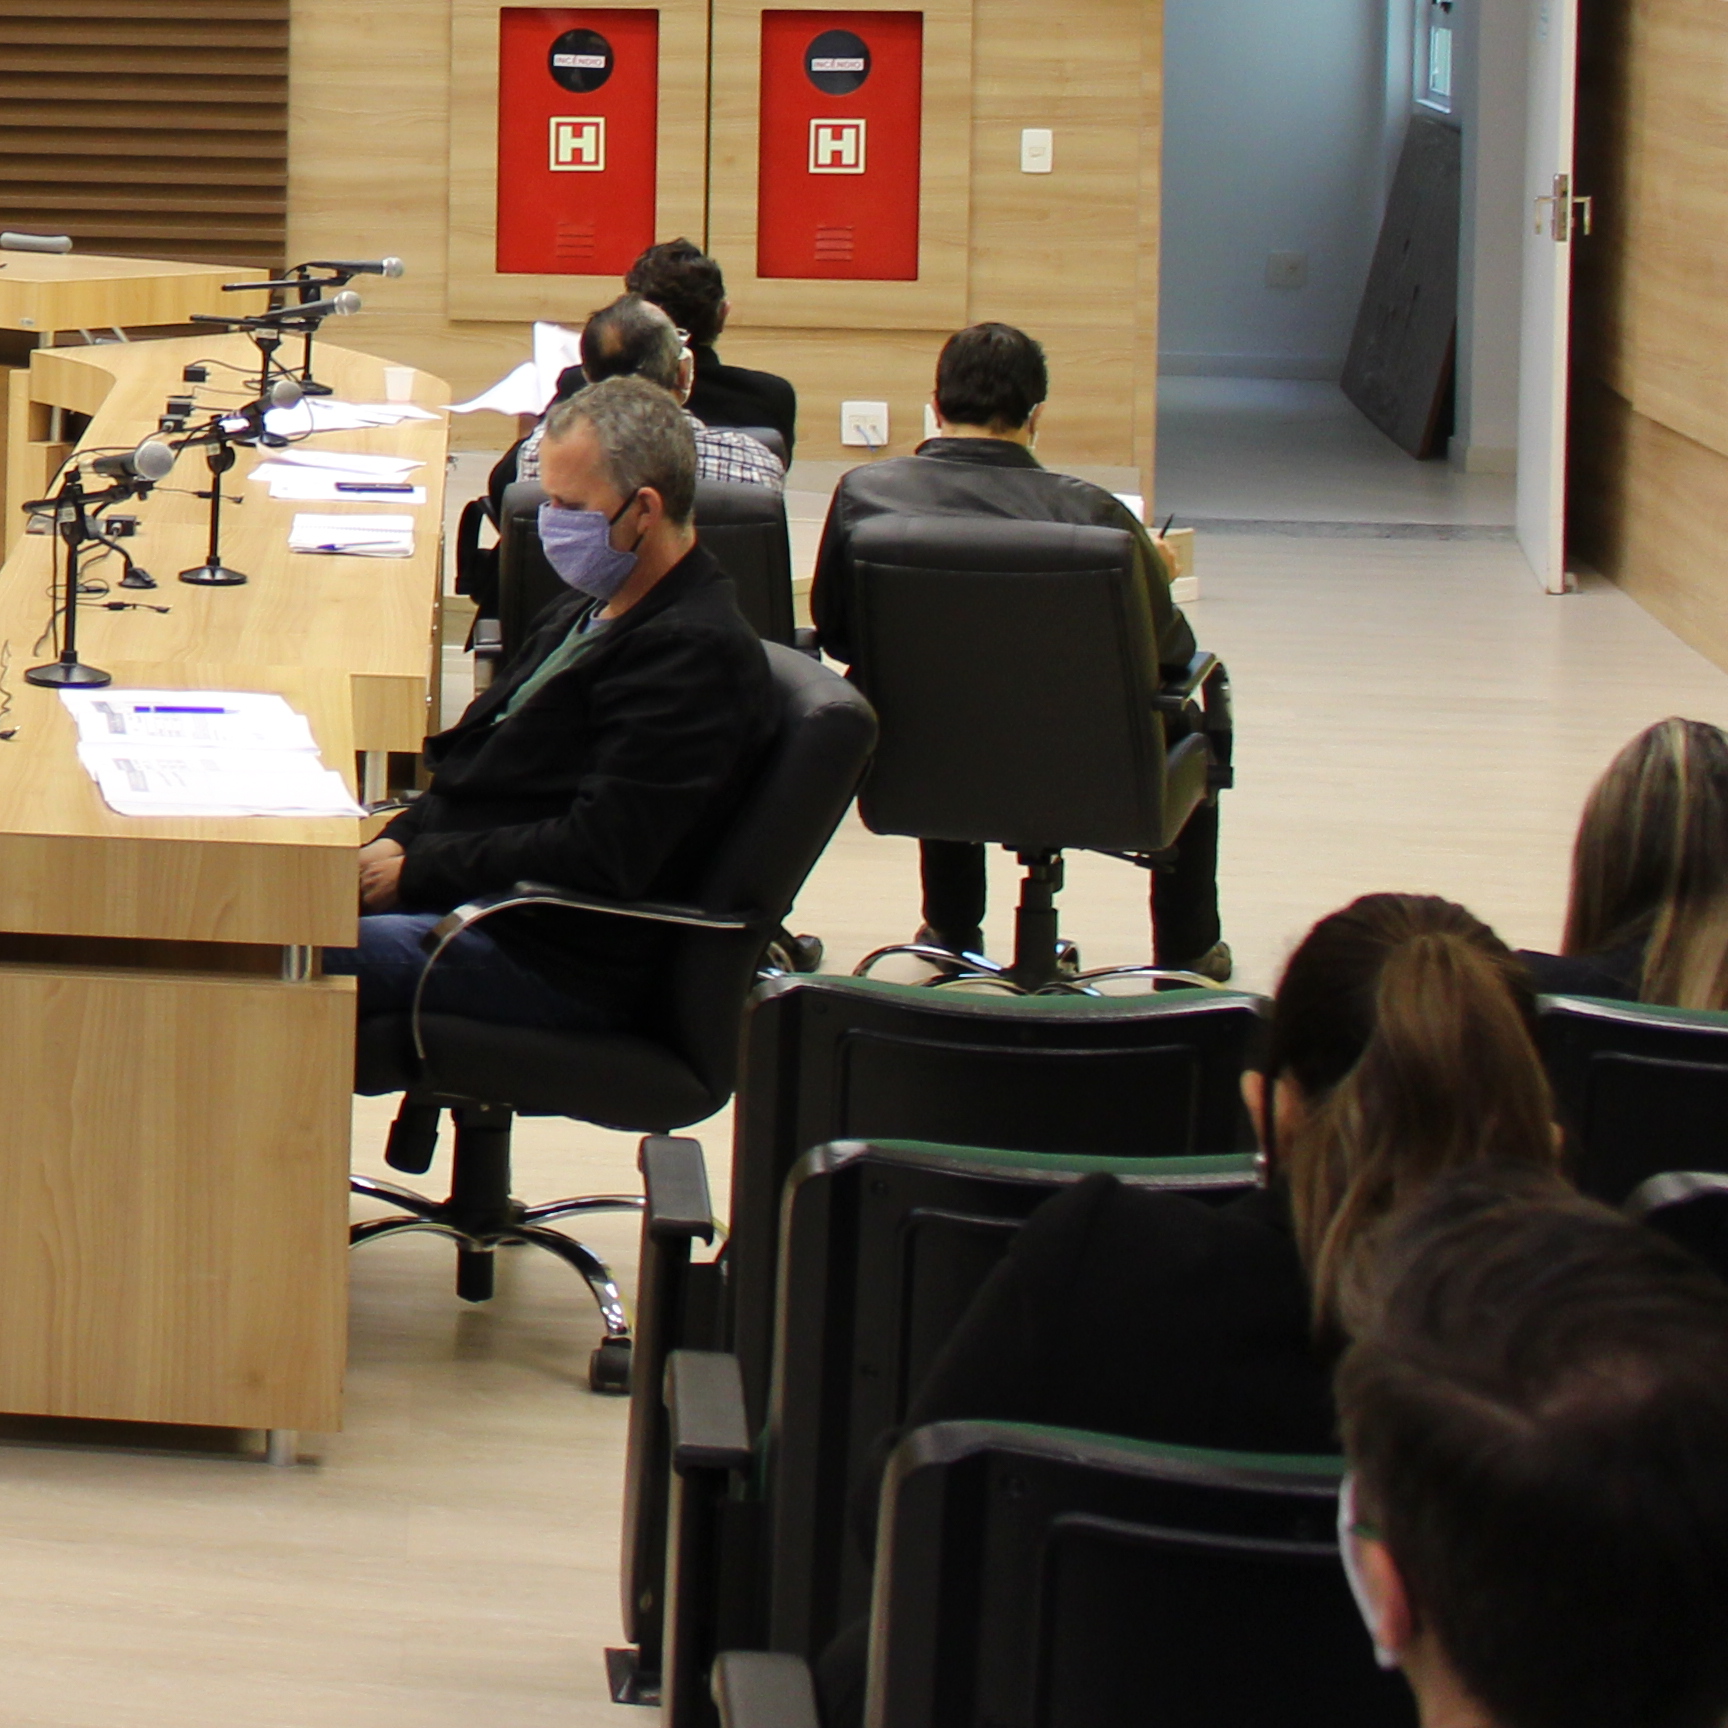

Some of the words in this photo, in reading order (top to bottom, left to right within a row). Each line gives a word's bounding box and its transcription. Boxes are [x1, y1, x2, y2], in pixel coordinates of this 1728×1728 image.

[555, 55, 603, 66] INCÊNDIO
[813, 59, 862, 69] INCÊNDIO
[557, 125, 597, 164] H
[817, 127, 857, 166] H
